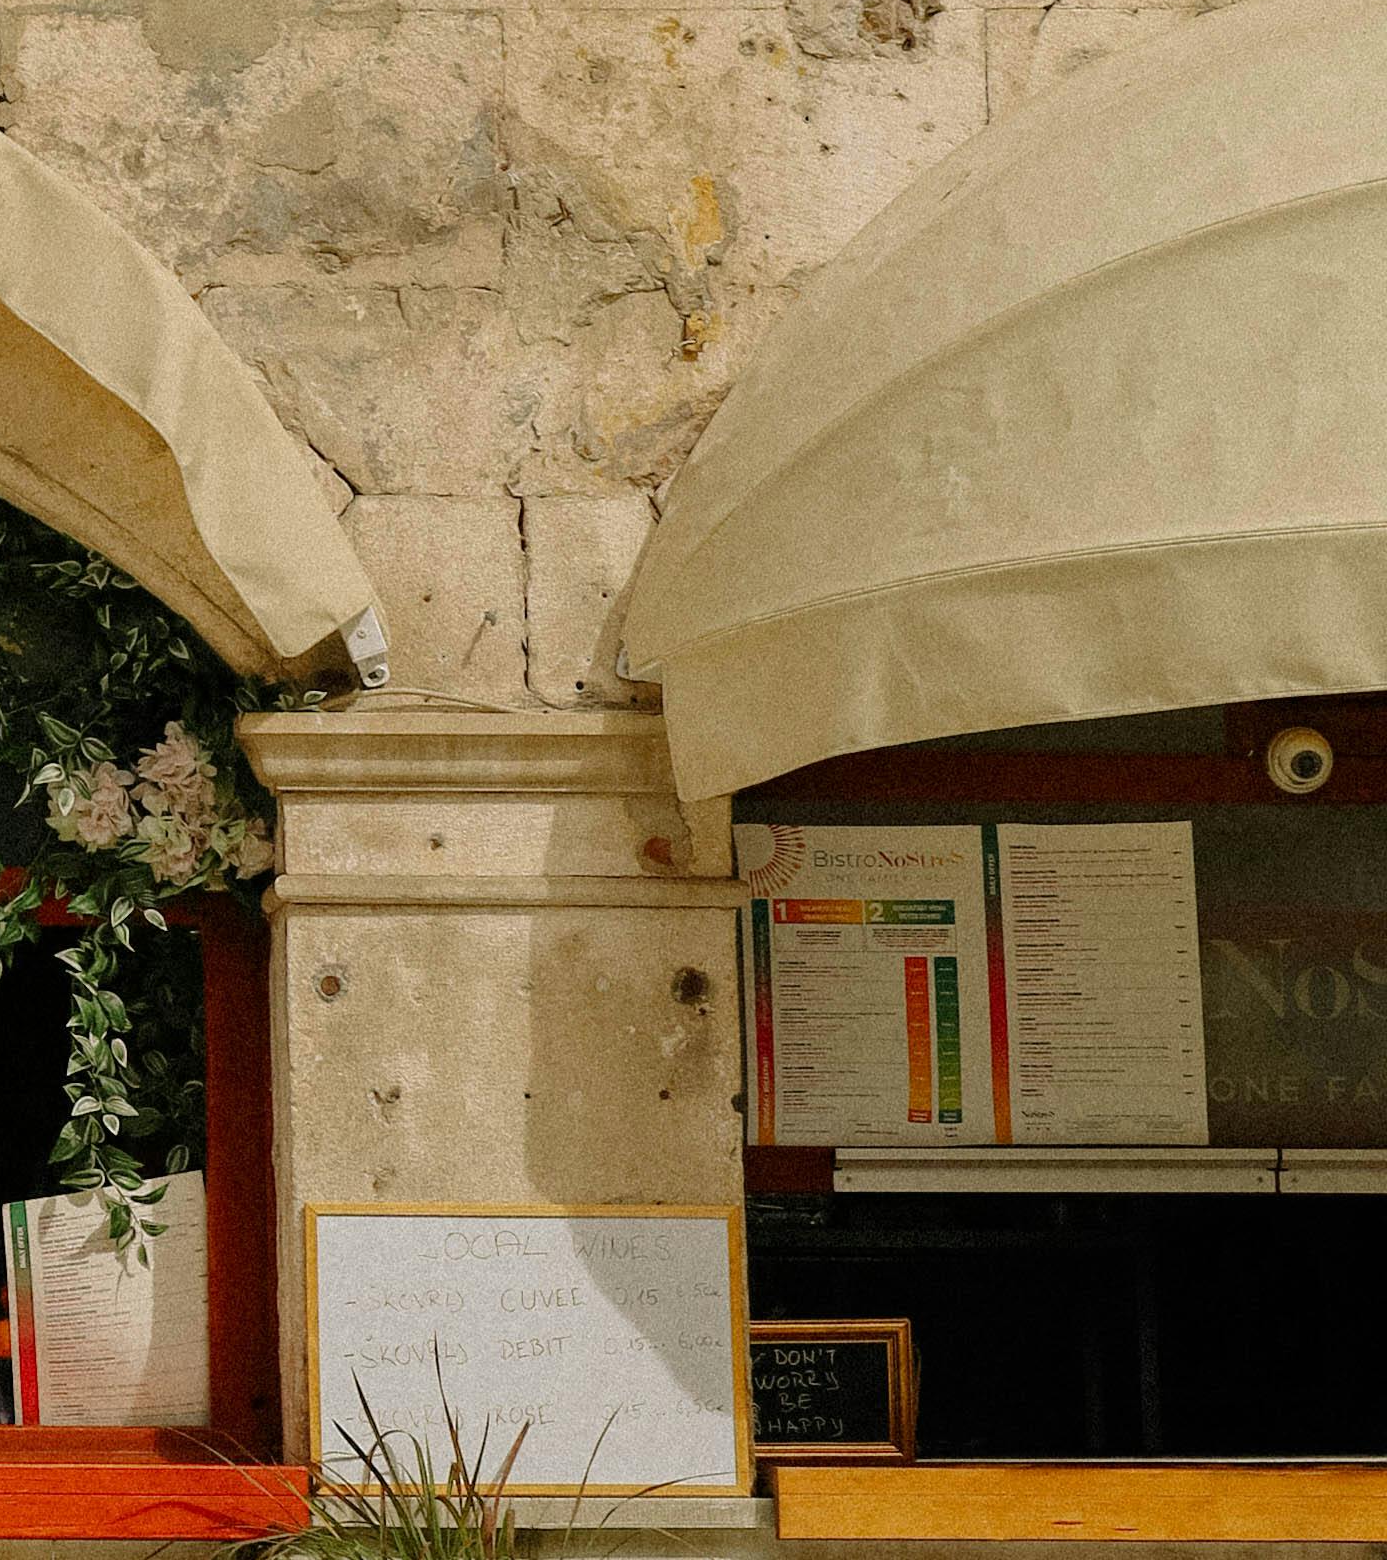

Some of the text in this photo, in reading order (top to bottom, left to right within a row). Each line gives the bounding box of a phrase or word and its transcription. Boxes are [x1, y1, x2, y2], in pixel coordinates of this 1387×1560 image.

[868, 902, 883, 922] 2
[773, 1348, 838, 1367] DON'T
[778, 1391, 813, 1414] BE
[767, 1415, 845, 1439] HAPPY
